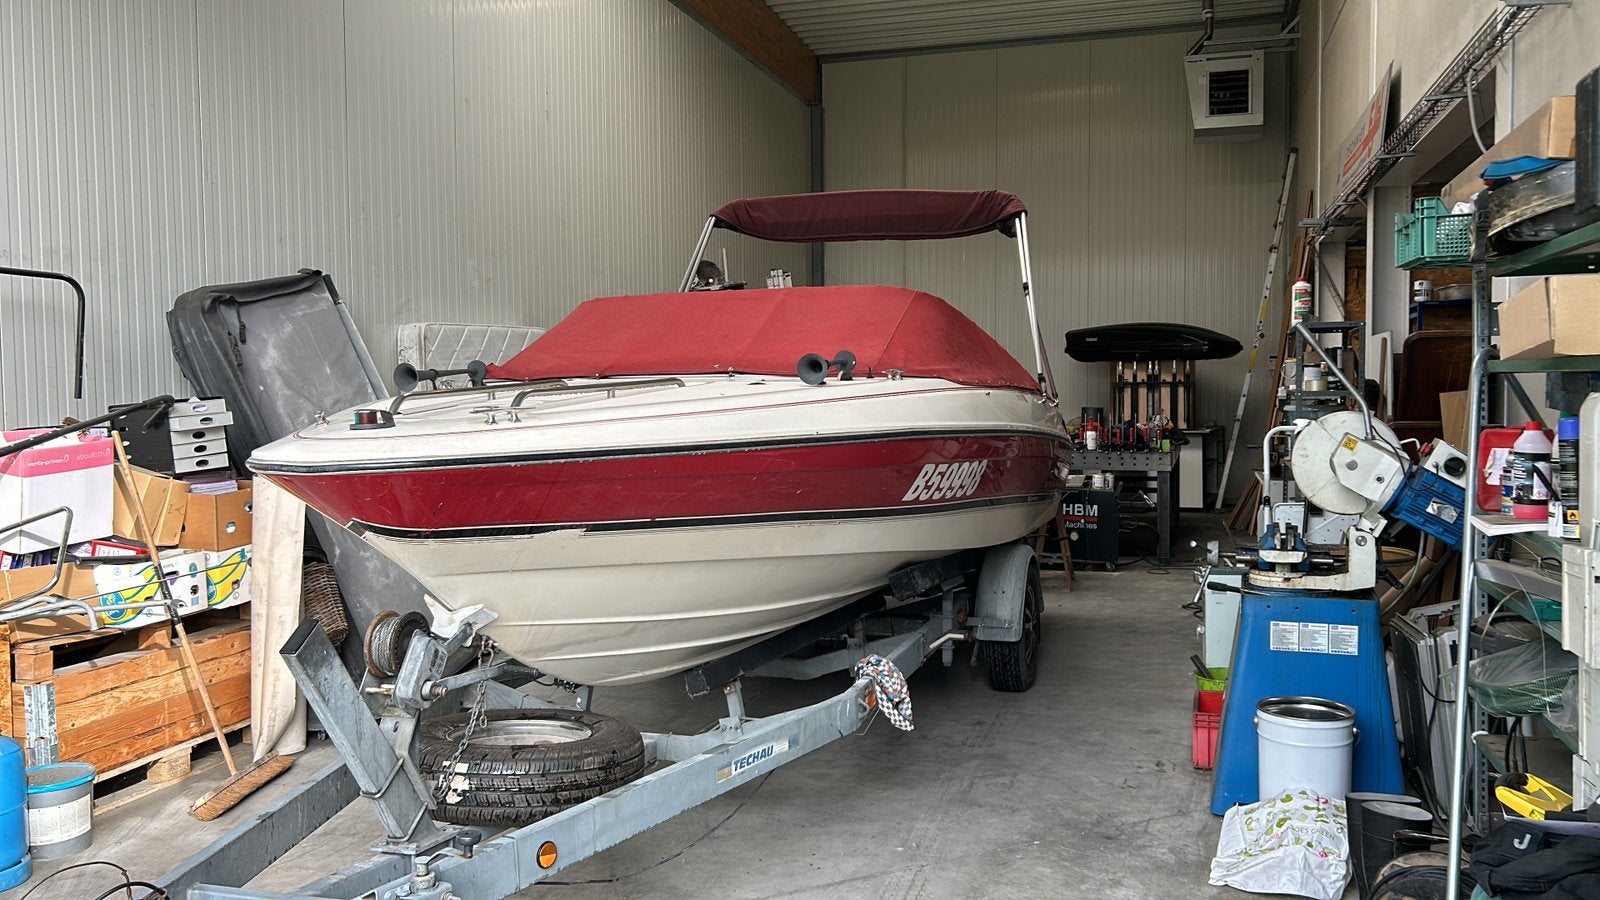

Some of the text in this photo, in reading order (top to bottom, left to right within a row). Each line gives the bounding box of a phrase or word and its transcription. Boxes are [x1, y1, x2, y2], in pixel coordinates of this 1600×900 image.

[902, 459, 988, 501] B59998
[1062, 503, 1098, 517] HBM
[1064, 521, 1098, 530] Machnes
[733, 744, 774, 772] TECHAU
